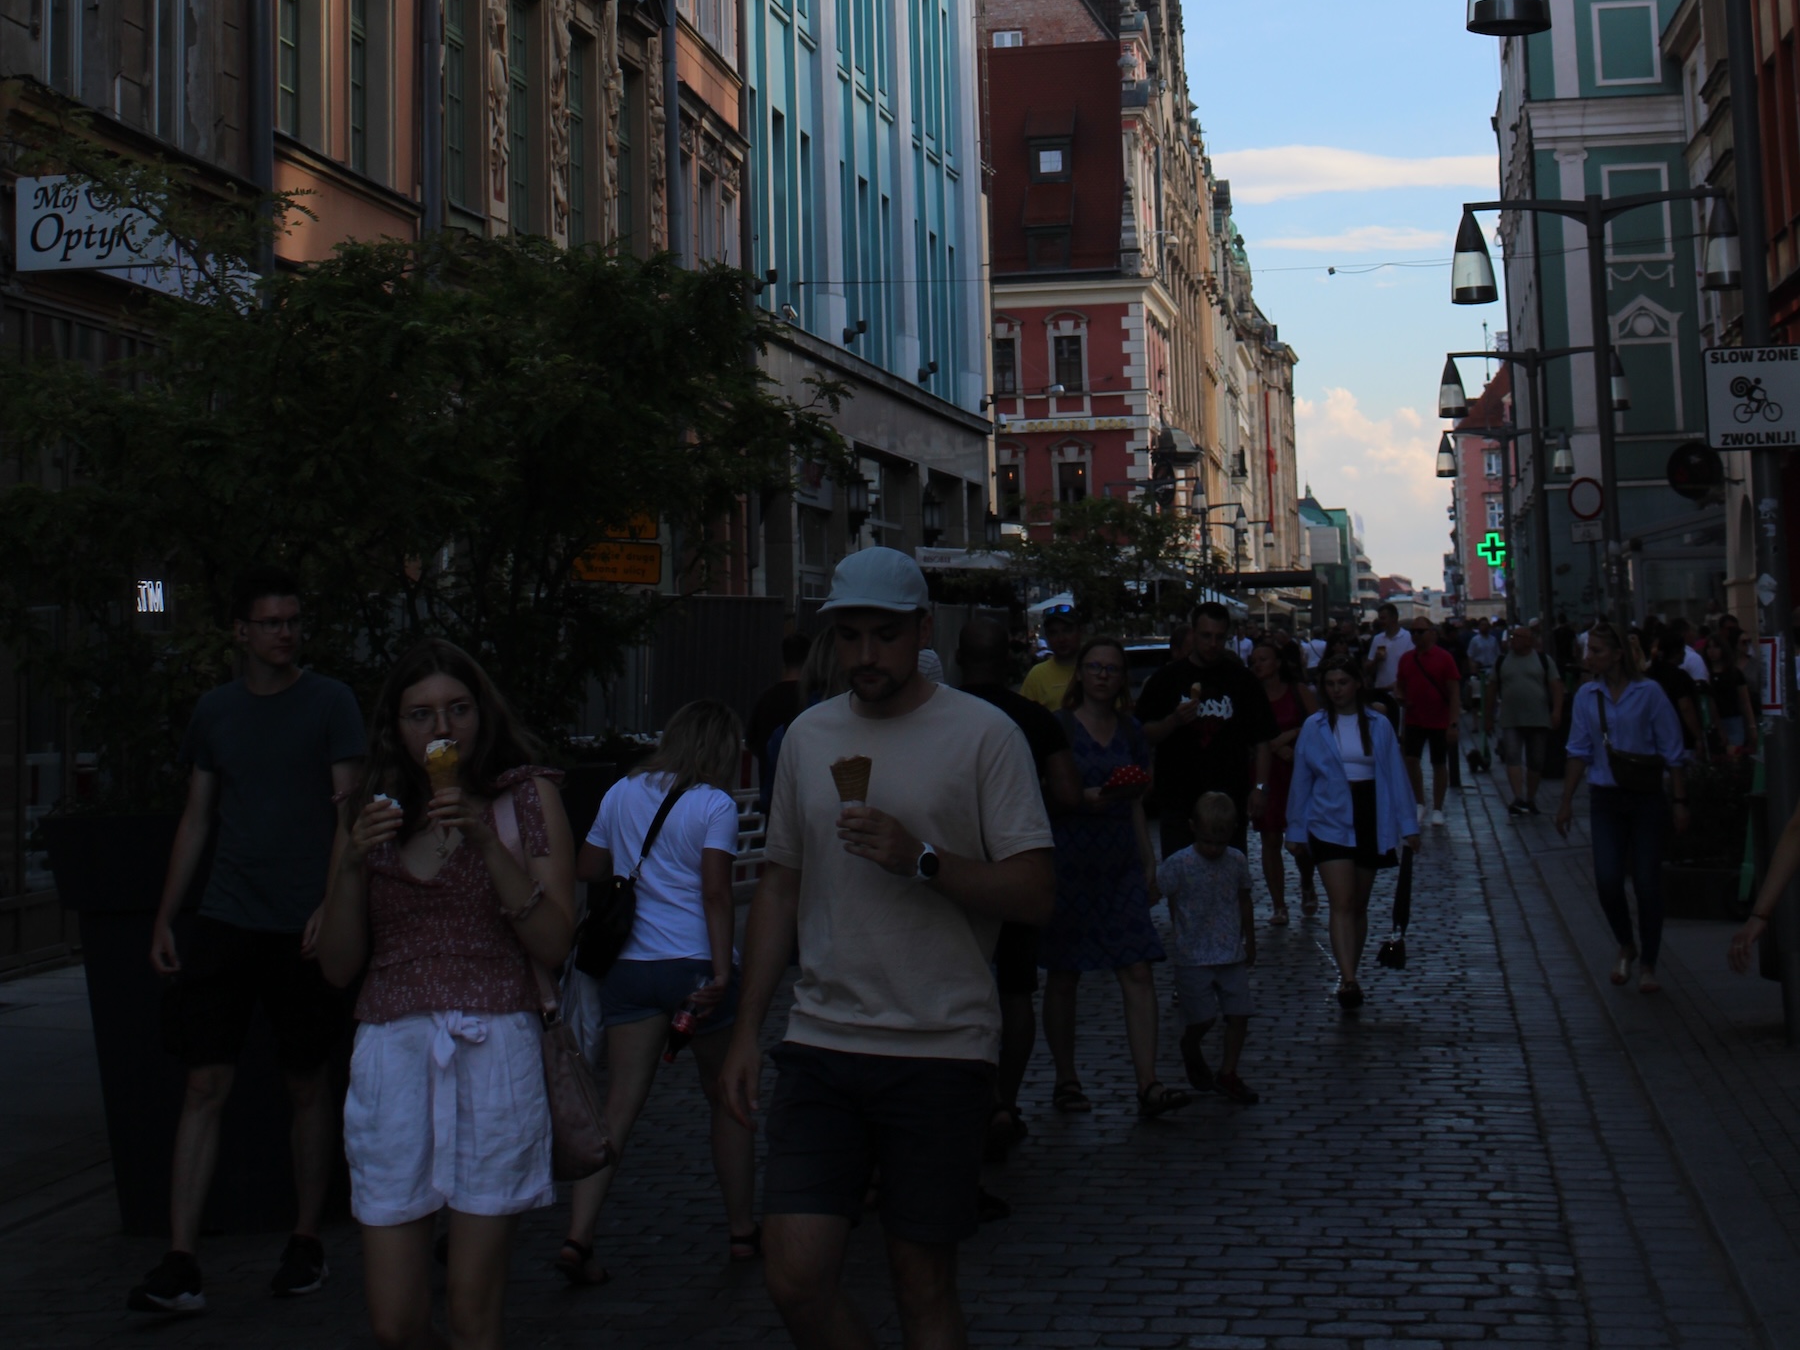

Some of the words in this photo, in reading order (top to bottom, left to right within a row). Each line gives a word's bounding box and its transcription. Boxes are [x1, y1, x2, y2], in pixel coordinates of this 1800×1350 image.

[33, 185, 79, 214] Mój
[30, 213, 139, 261] Optyk
[1710, 351, 1754, 364] SLOW
[1757, 349, 1799, 362] ZONE
[1026, 419, 1090, 433] GOLDEN
[1094, 418, 1128, 430] DOG
[1721, 431, 1796, 446] ZWOLNIJ!
